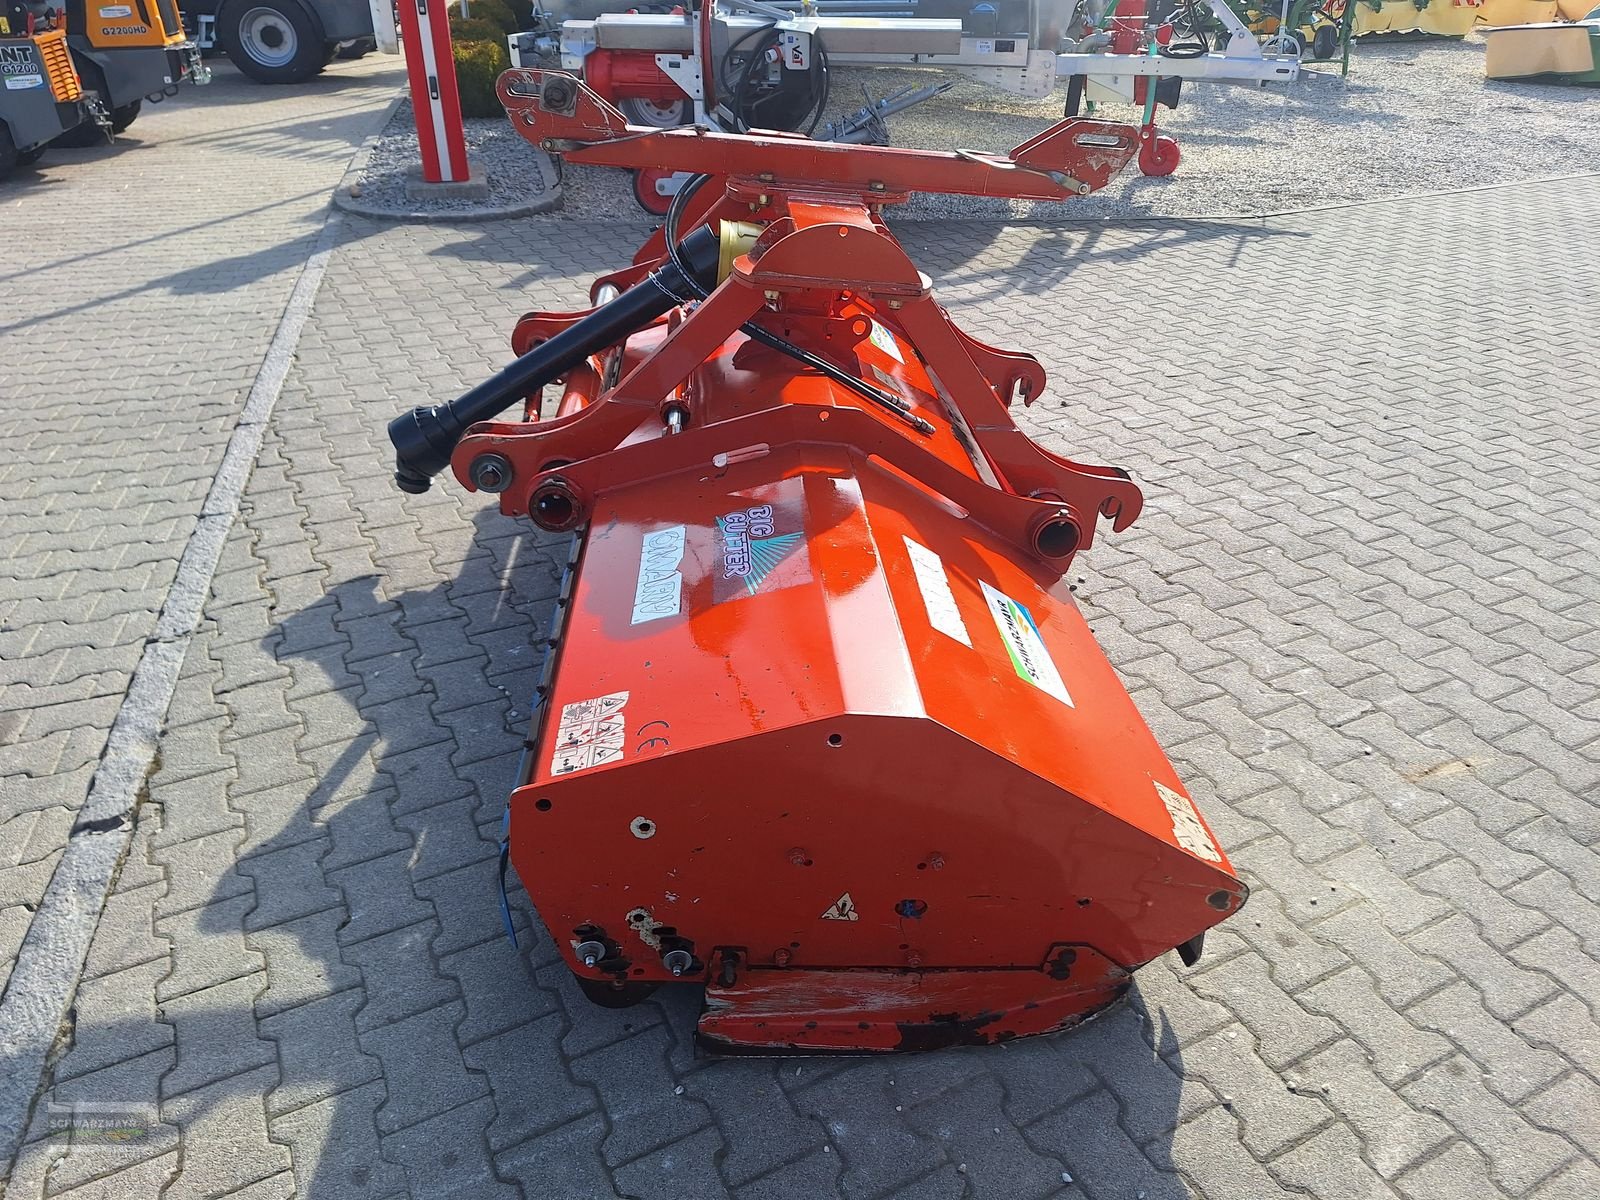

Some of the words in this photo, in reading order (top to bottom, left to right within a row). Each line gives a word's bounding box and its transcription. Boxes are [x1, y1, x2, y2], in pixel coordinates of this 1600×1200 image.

[102, 26, 147, 35] G2200HD
[1, 63, 38, 74] G1200
[748, 505, 774, 536] BIG
[723, 512, 752, 579] CUTTER
[997, 599, 1039, 680] SCHWARZMAYR
